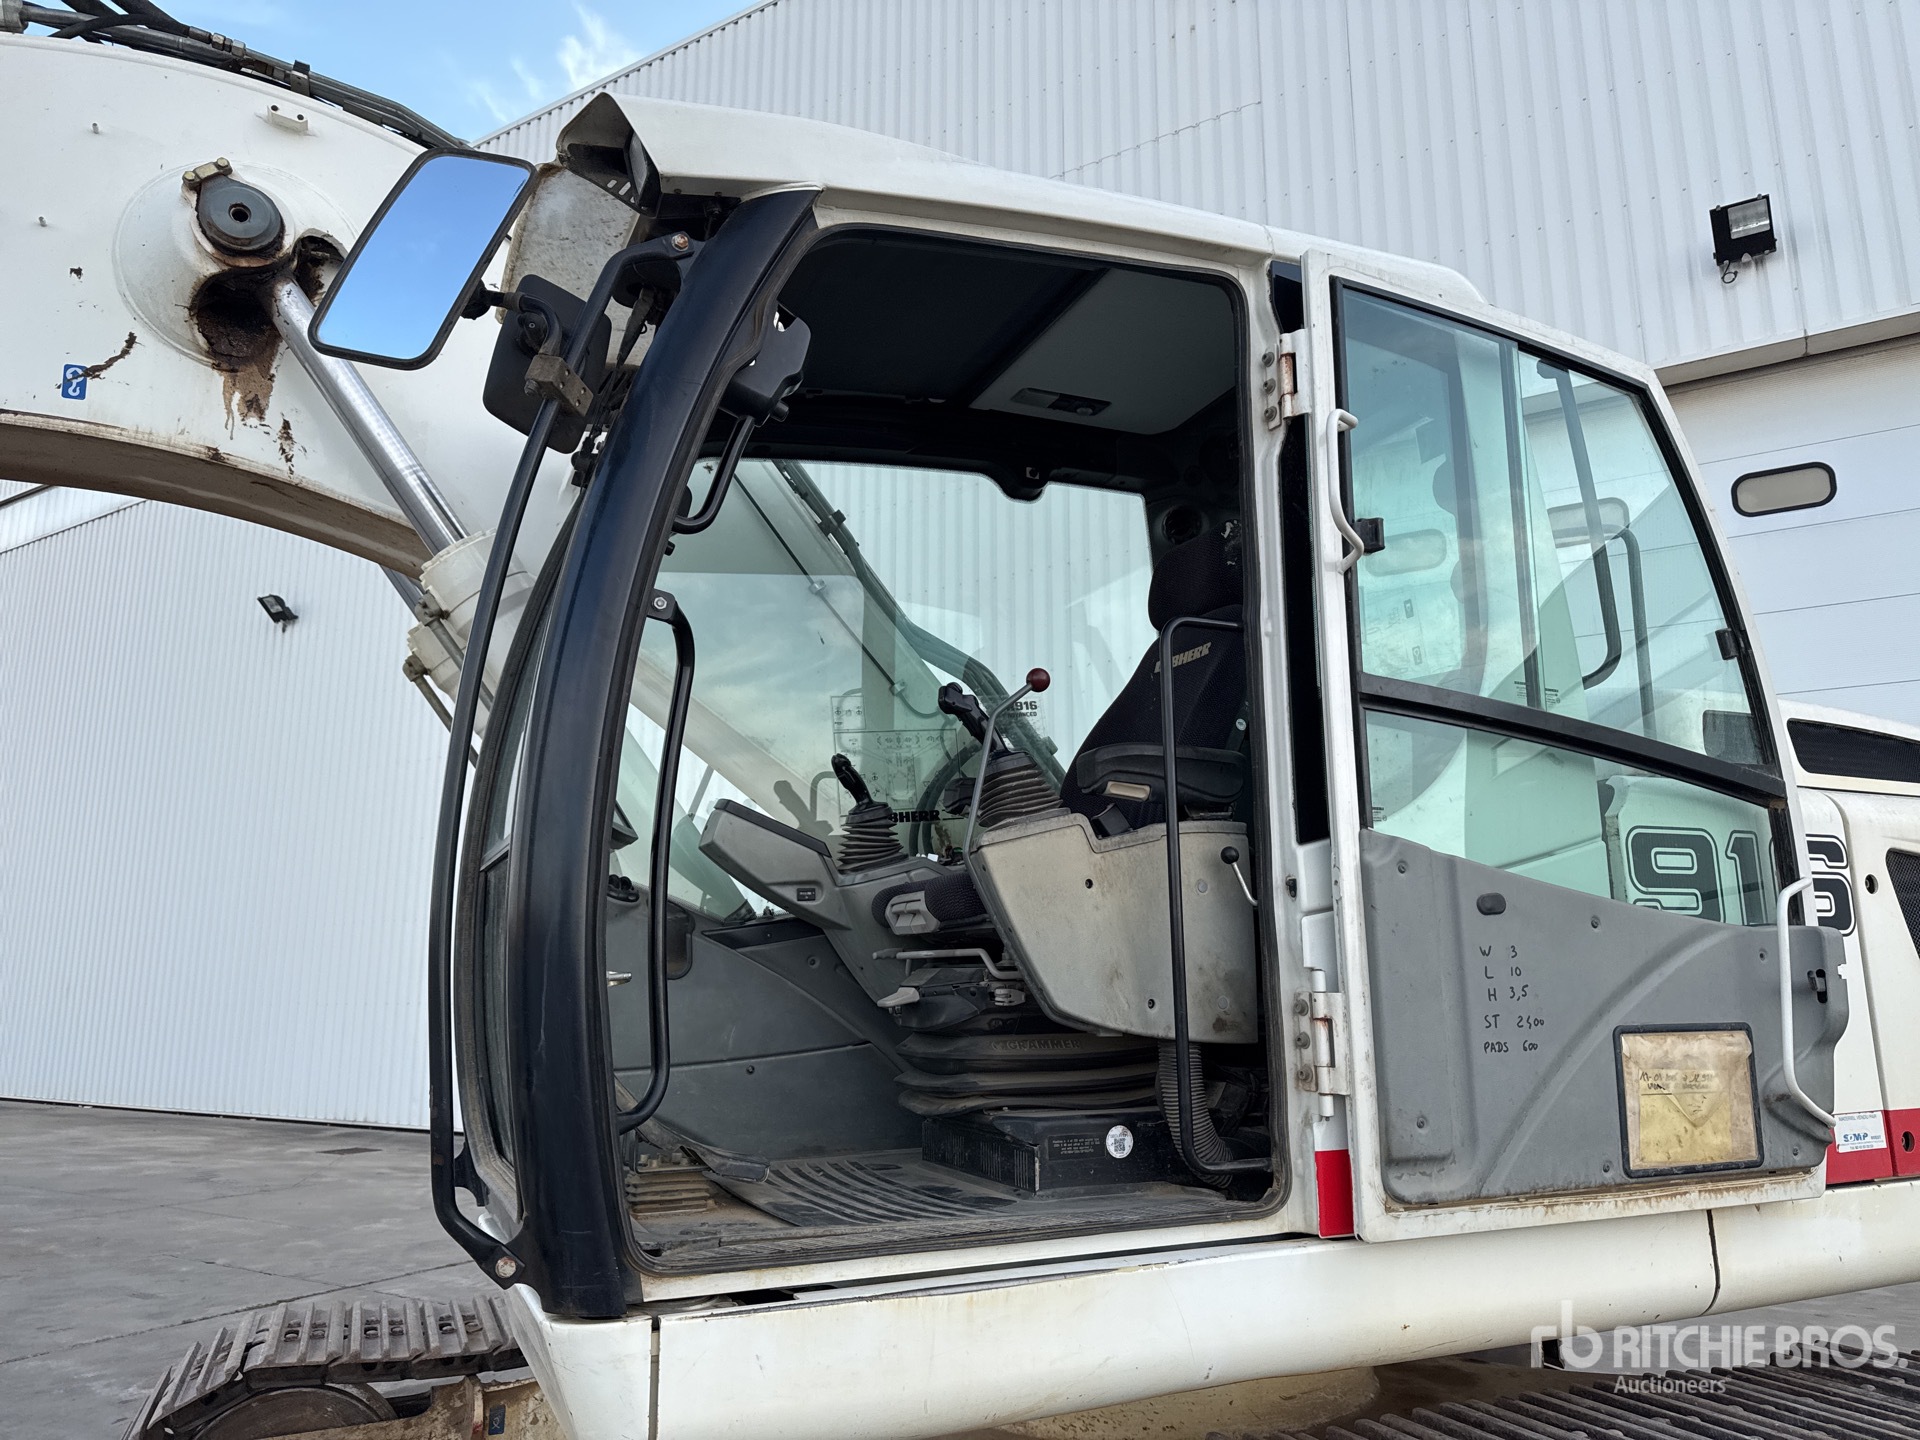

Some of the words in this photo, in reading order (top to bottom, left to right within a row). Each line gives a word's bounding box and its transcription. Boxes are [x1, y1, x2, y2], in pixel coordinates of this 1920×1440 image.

[1153, 641, 1212, 673] LBHERR
[1479, 945, 1492, 957] W
[1510, 945, 1518, 959] 3
[1484, 965, 1494, 979] L
[1510, 966, 1522, 977] 10
[1487, 987, 1497, 1001] H
[1509, 984, 1529, 1001] 3,5
[1484, 1014, 1500, 1029] ST
[1007, 1039, 1080, 1050] GRAMMER
[1484, 1041, 1509, 1054] PADS
[1522, 1040, 1539, 1052] 600
